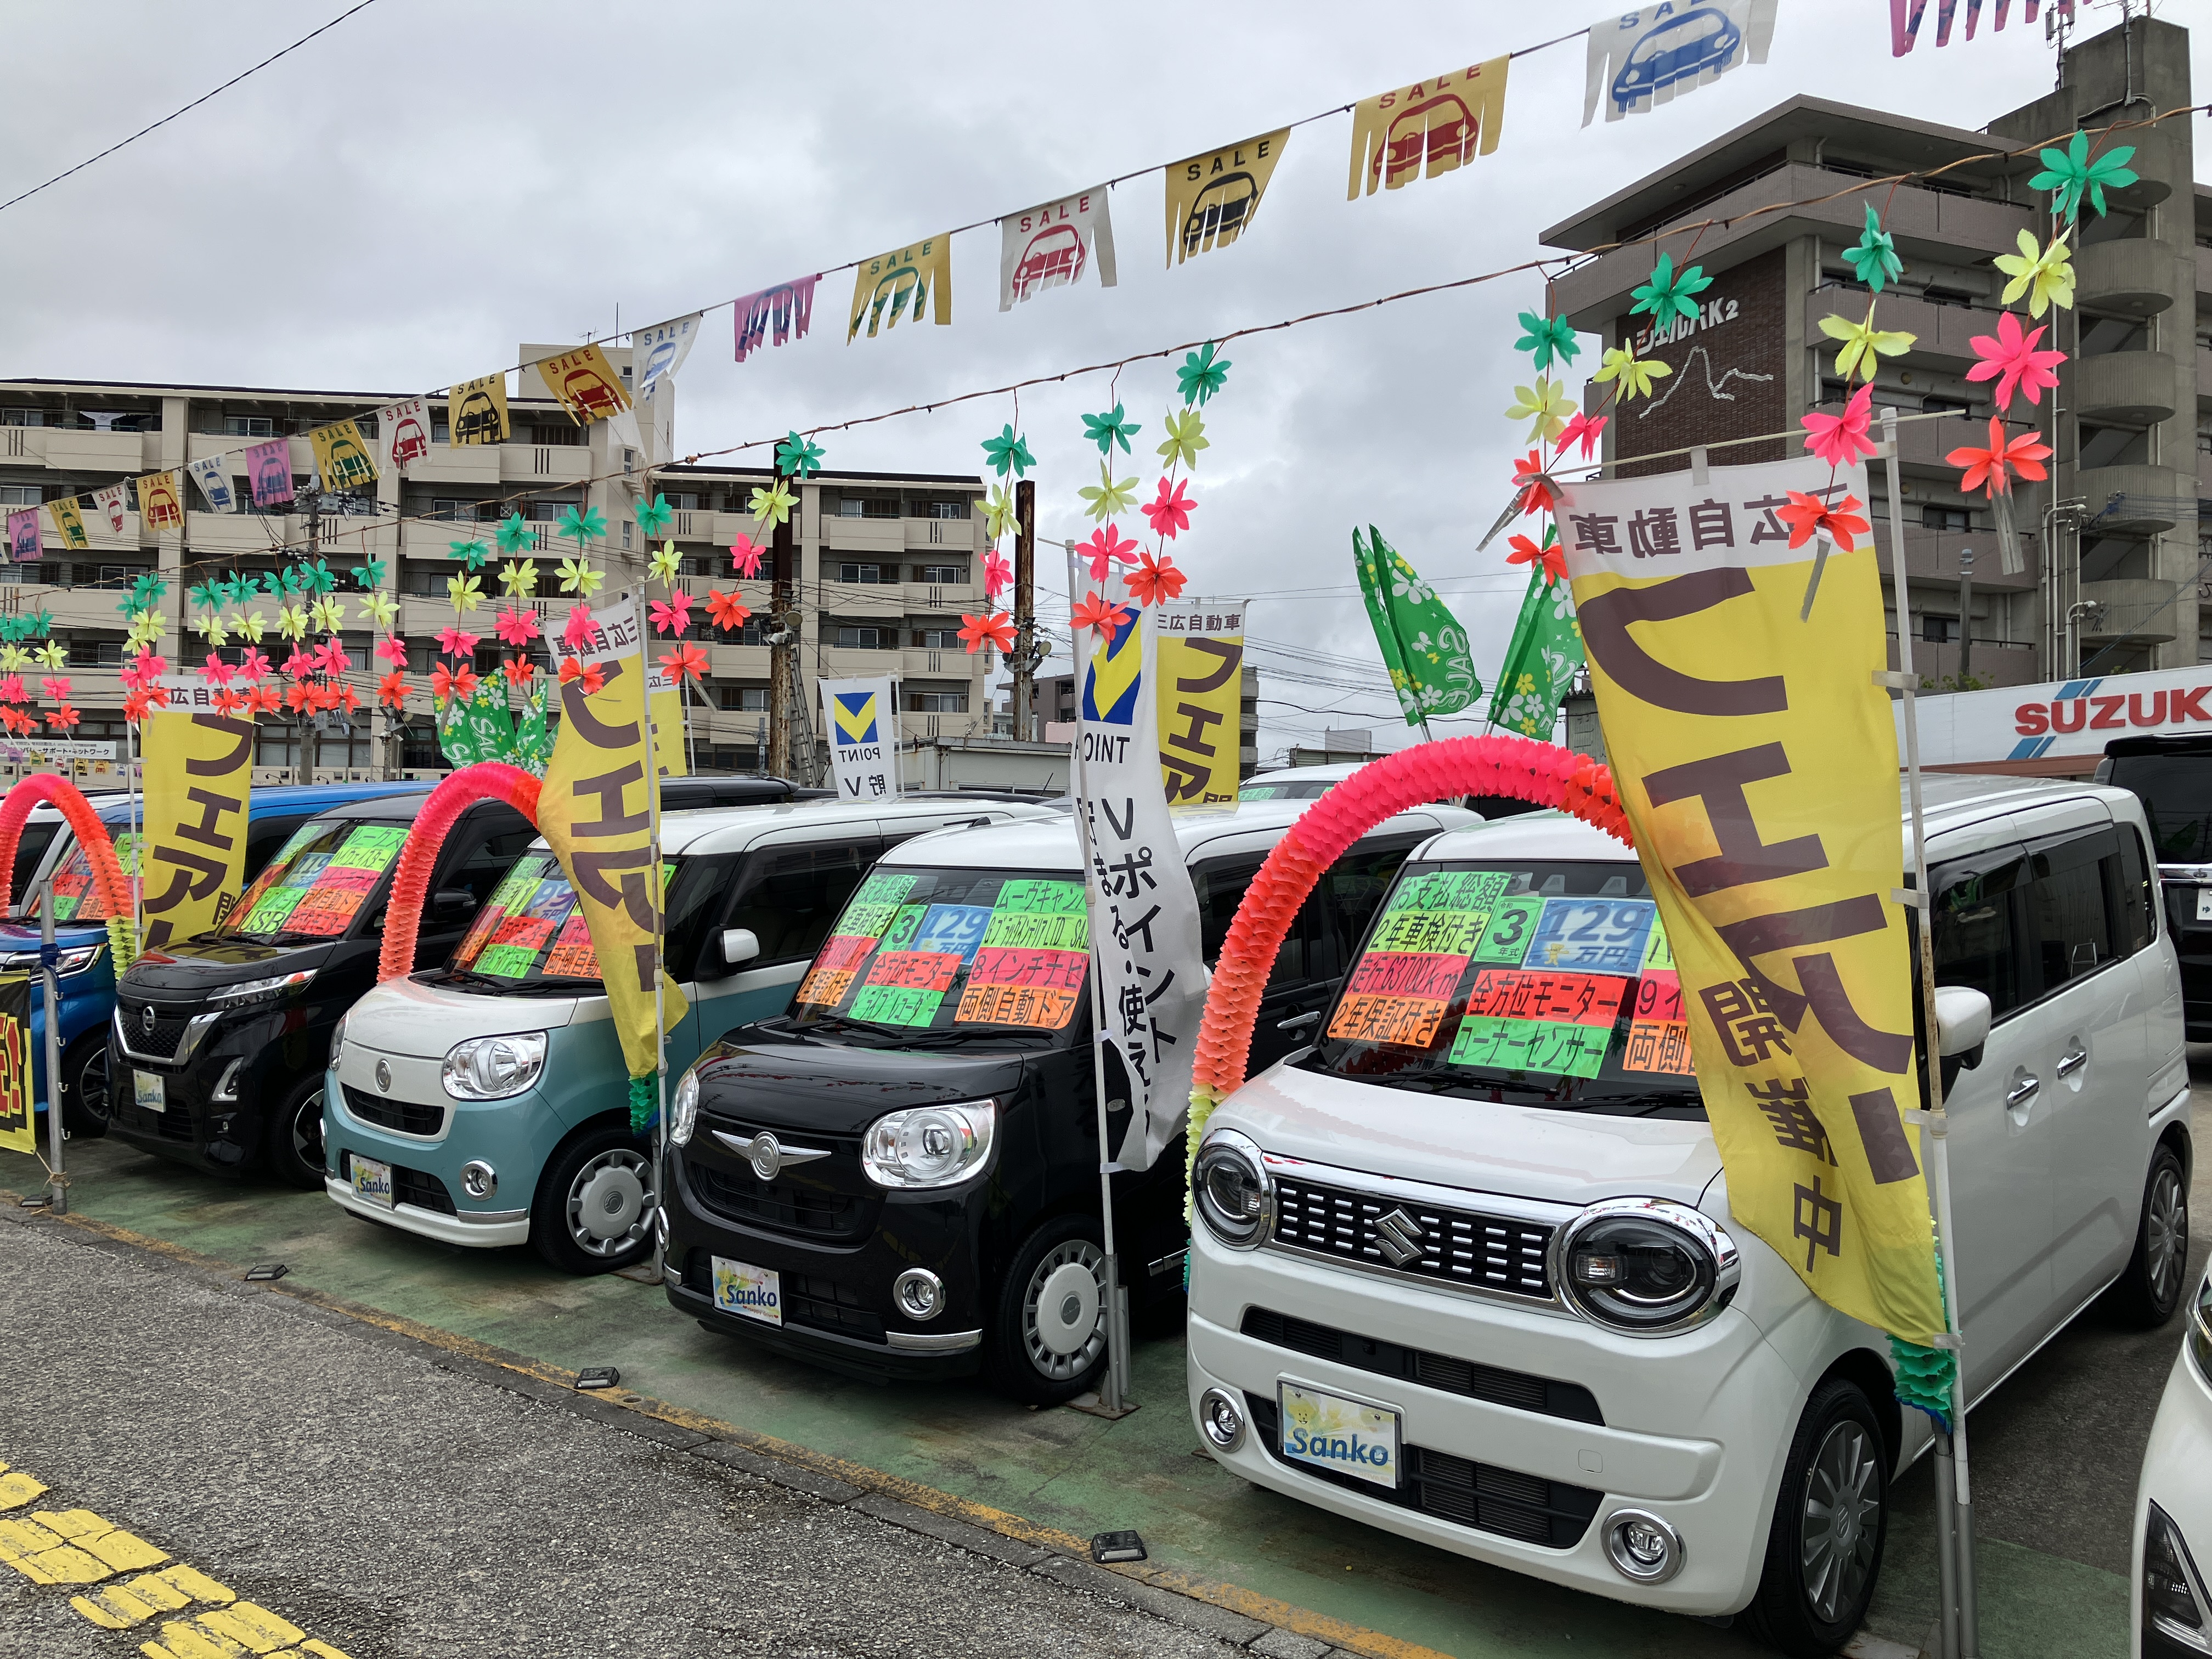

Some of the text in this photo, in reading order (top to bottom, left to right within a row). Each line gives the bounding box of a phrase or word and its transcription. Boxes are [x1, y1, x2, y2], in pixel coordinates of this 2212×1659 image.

[1619, 0, 1705, 30] SA
[1379, 63, 1482, 109] SALE
[1187, 140, 1271, 182] SALE
[1020, 195, 1090, 233] SALE
[870, 241, 933, 275] SALE
[644, 321, 690, 346] SALE
[549, 349, 594, 374] SALE
[457, 373, 496, 394] SALE
[386, 400, 421, 421] SALE
[318, 424, 352, 442] SALE
[194, 457, 221, 472] SALE
[99, 487, 122, 501] SALE
[142, 474, 170, 489] SALE
[53, 500, 75, 512] SALE
[1158, 613, 1241, 631] 三広自動車
[1159, 637, 1243, 804] フェア
[2015, 686, 2212, 736] SUZUK
[441, 743, 474, 768] SA
[1391, 872, 1512, 912] お支払総額
[892, 915, 916, 944] 3
[919, 909, 987, 939] 129
[1101, 798, 1177, 1063] Vポイント
[1370, 913, 1484, 953] 2年車検付き
[1492, 909, 1529, 946] 3
[1537, 904, 1649, 943] 129
[937, 942, 970, 955] 万円
[1498, 947, 1520, 957] 年式
[1573, 945, 1628, 966] 万円
[867, 953, 954, 988] 全方位モニター
[972, 950, 1088, 989] 8インチナビ
[961, 986, 1077, 1027] 両側自動ドア
[1468, 972, 1619, 1023] 全方位モニター
[1329, 997, 1442, 1045] 2年保証付き
[1453, 1021, 1604, 1073] コーナーセンサー
[1627, 1023, 1695, 1074] 両側
[137, 1089, 161, 1104] Sanko
[359, 1177, 390, 1194] Sanko
[726, 1284, 777, 1307] Sanko
[1291, 1427, 1388, 1466] Sanko
